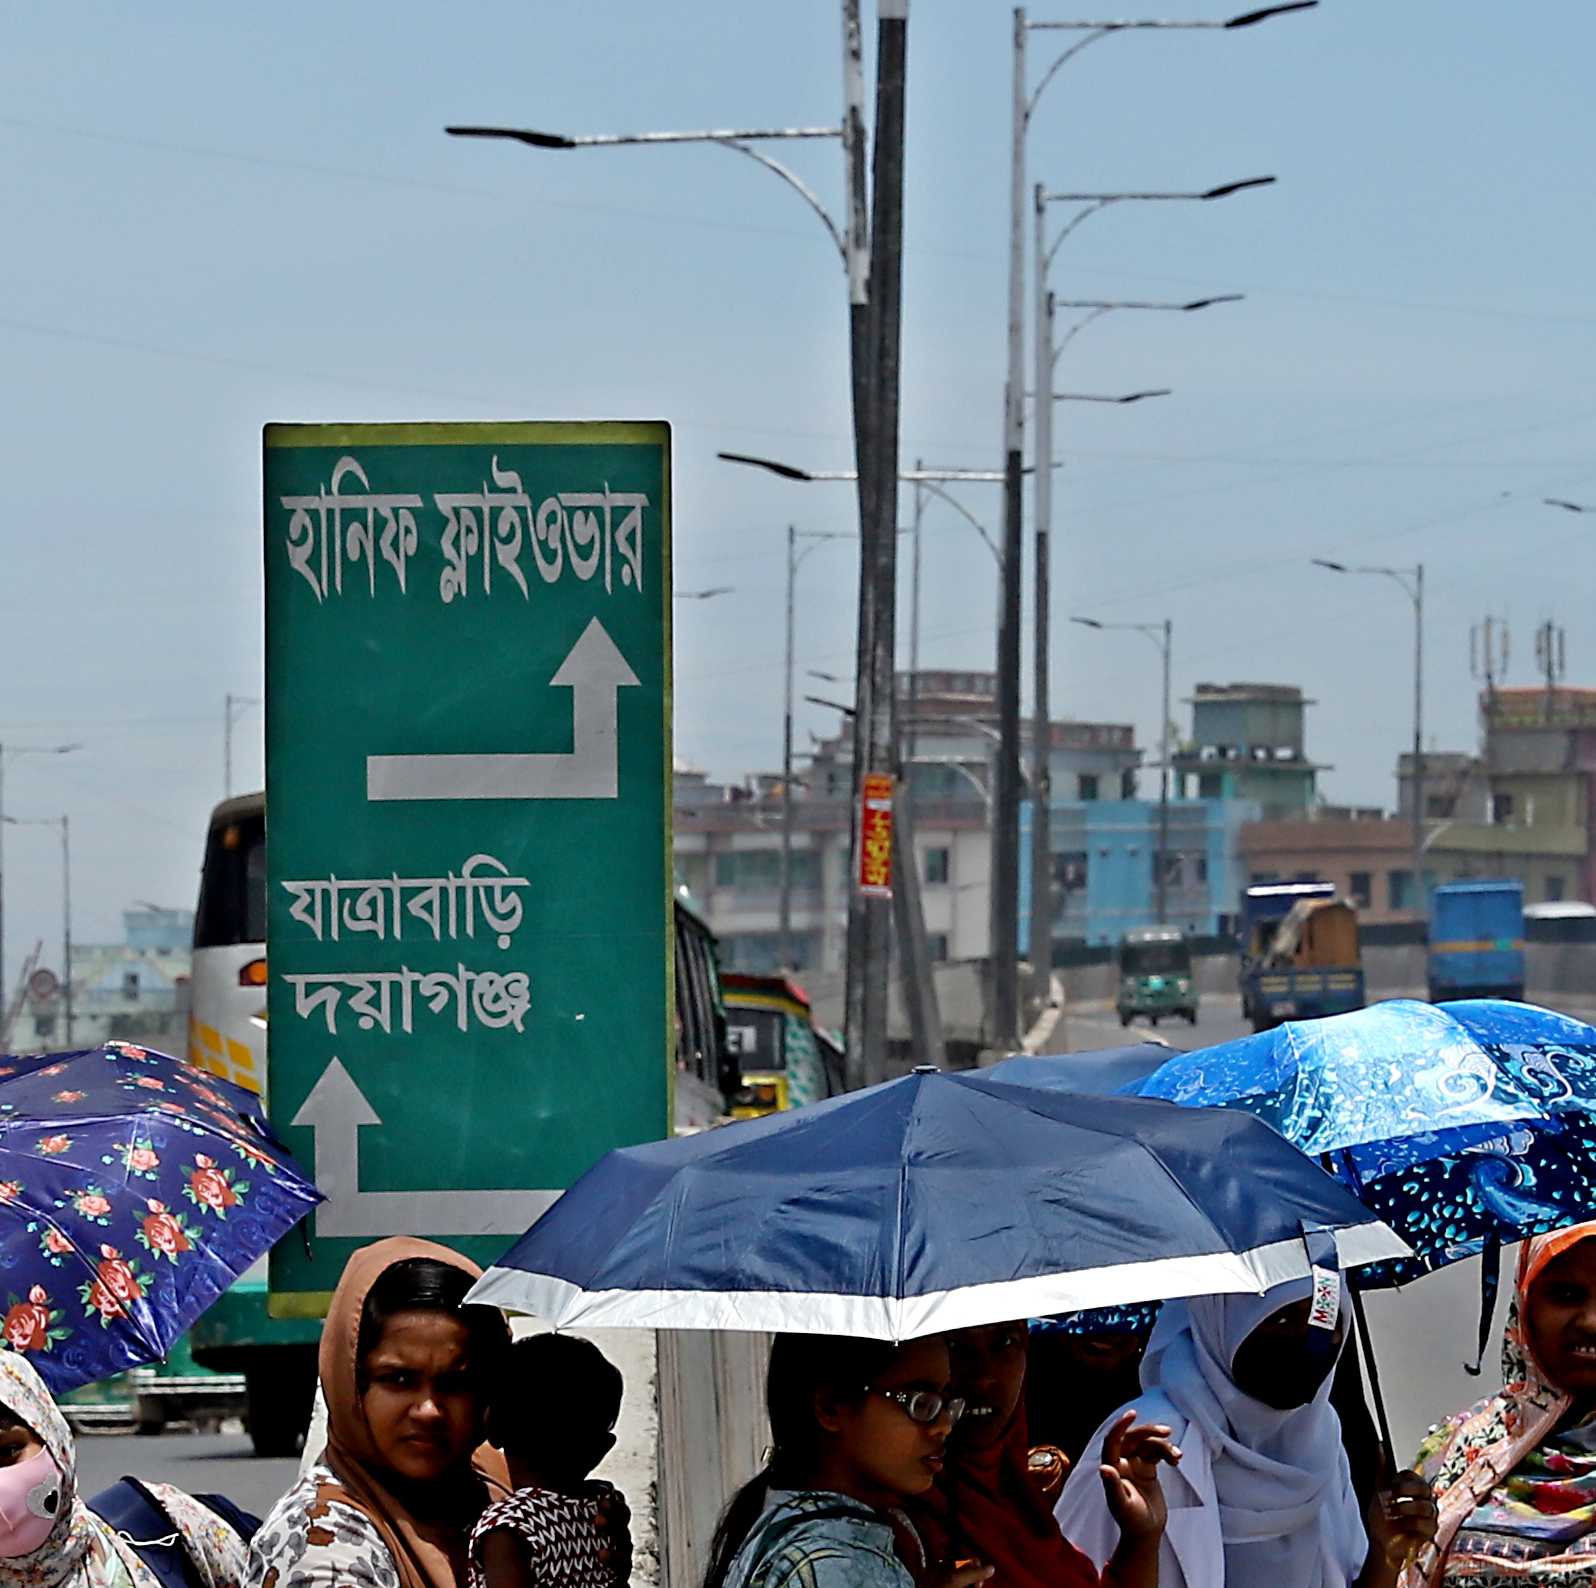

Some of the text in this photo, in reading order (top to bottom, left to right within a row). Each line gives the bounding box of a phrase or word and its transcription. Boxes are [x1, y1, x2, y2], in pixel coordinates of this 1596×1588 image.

[280, 455, 650, 604] হানিফ ফ্লাইওভার
[280, 853, 531, 951] যাত্রাবাড়ি
[282, 962, 532, 1035] দয়াগঞ্জ
